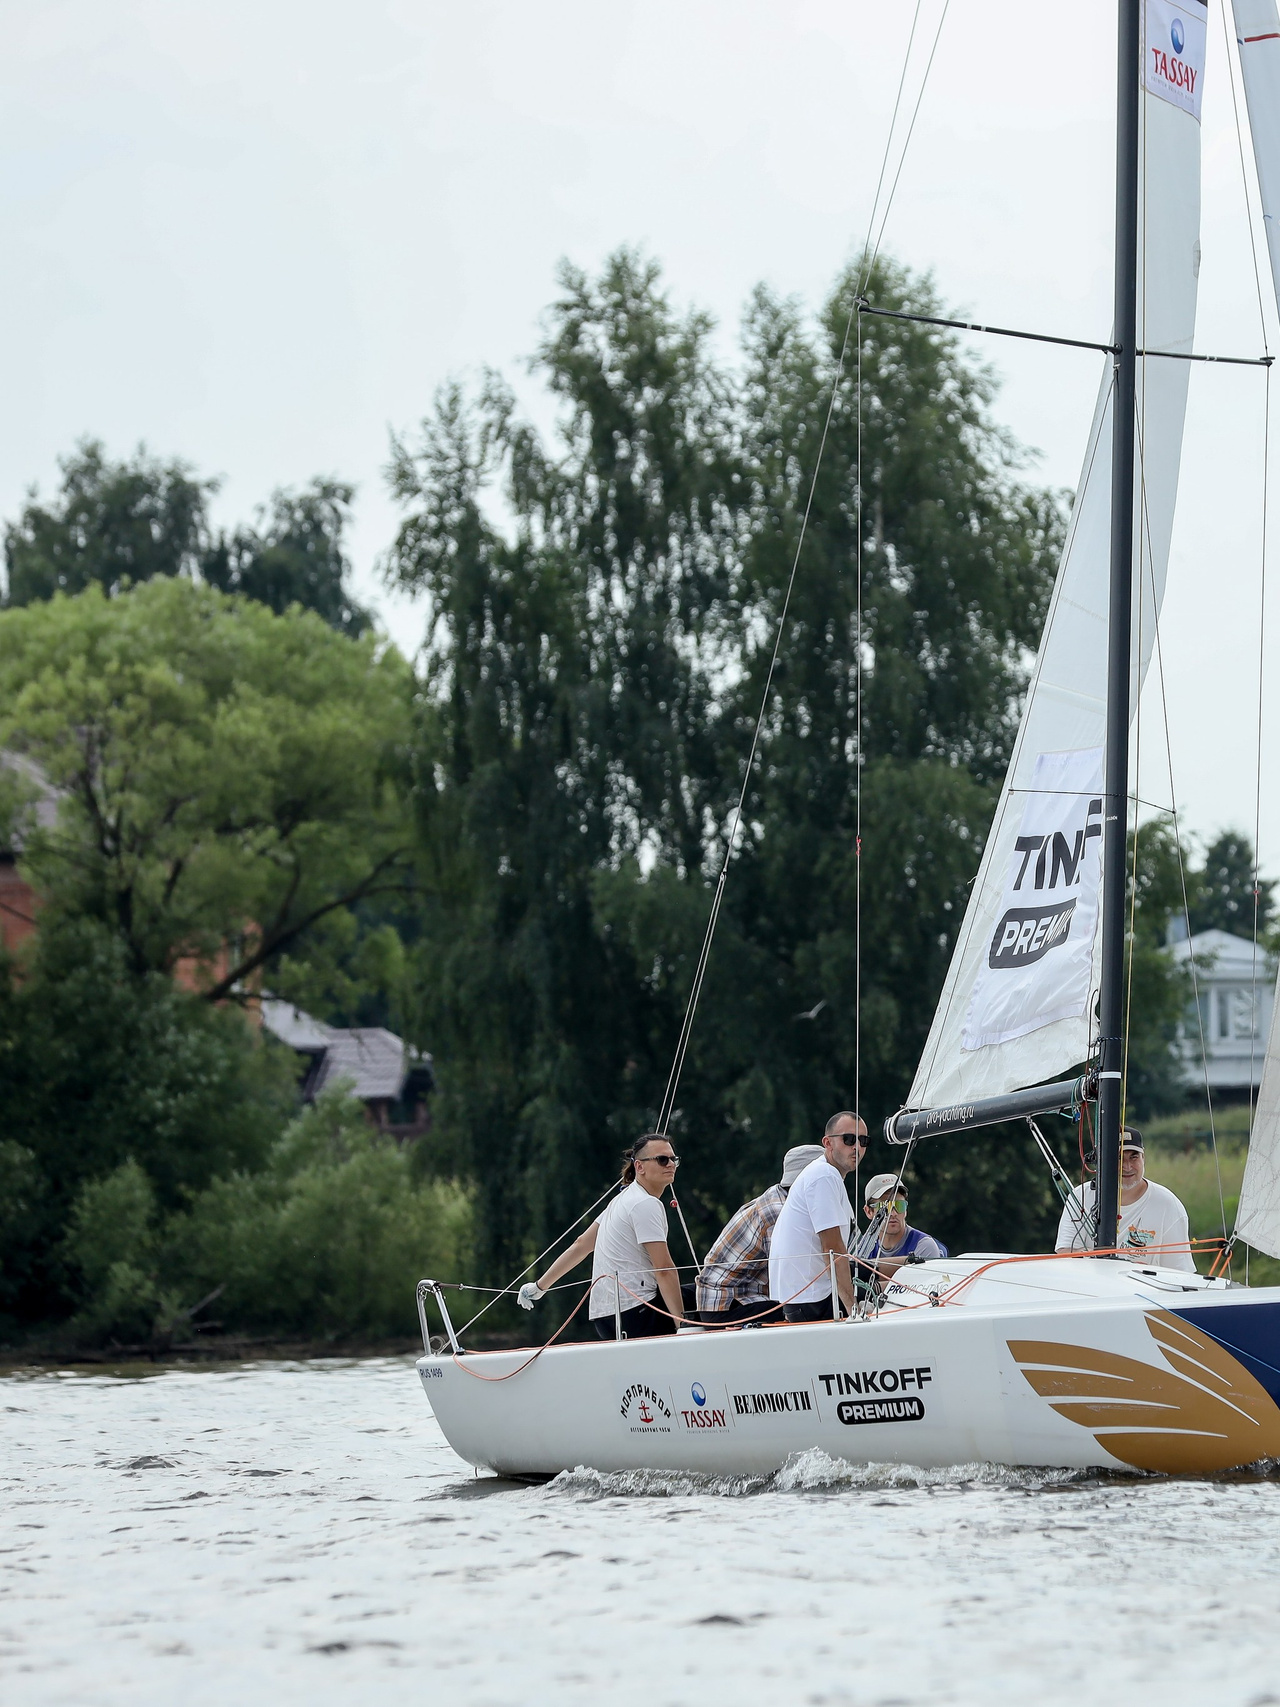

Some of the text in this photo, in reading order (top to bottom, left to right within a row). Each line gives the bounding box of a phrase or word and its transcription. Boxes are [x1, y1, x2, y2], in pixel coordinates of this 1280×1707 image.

[1151, 47, 1198, 94] TASSAY
[926, 1105, 975, 1129] pro-yachting.ru
[818, 1366, 932, 1397] TINKOFF
[620, 1383, 672, 1419] МОРПРИБОР
[733, 1390, 812, 1415] ВЕДОМОСТИ
[841, 1400, 920, 1421] PREMIUM
[681, 1409, 727, 1428] TASSAY
